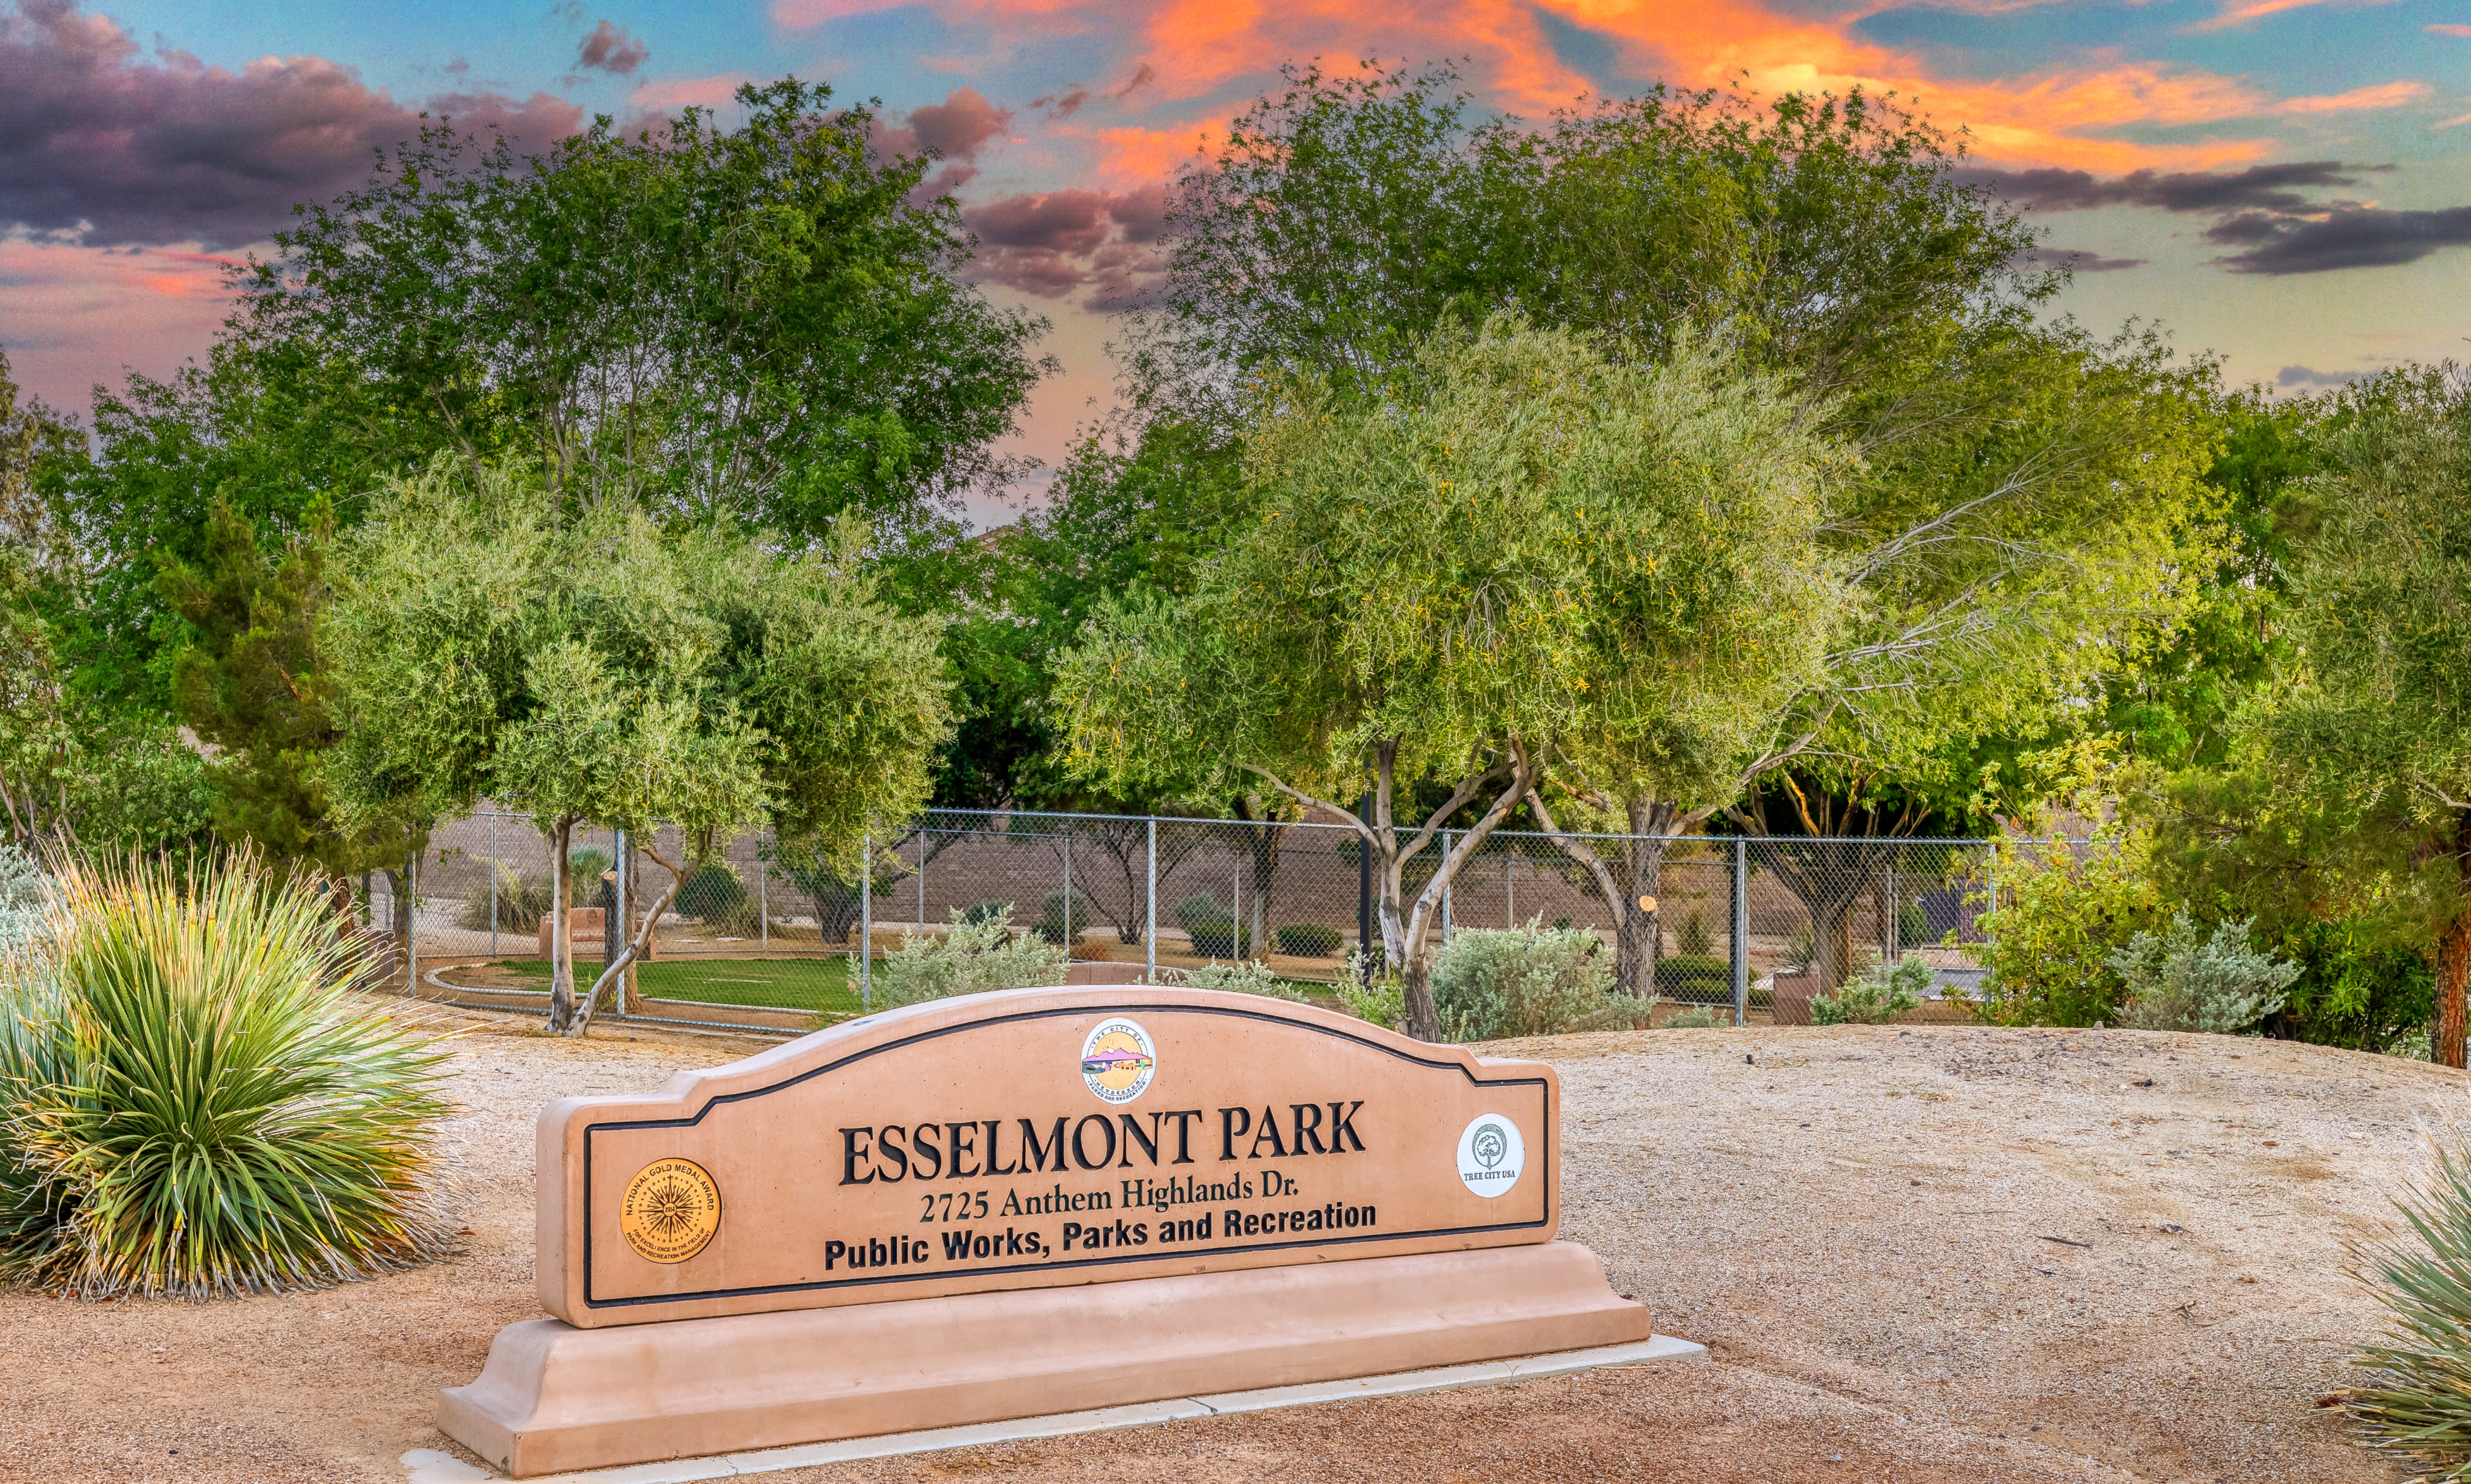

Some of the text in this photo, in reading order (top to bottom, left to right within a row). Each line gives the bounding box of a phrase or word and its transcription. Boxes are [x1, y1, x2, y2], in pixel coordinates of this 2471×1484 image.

[1093, 1031, 1105, 1046] THE
[1133, 1033, 1141, 1042] OF
[1089, 1083, 1104, 1098] PARKS
[1116, 1081, 1147, 1101] RECREATION
[1096, 1079, 1140, 1095] HENDERSON
[838, 1100, 1367, 1186] ESSELMONT PARK
[1464, 1173, 1483, 1181] TREE
[1485, 1171, 1500, 1179] CITY
[626, 1164, 714, 1216] NATIONAL GOLD MEDAL AWARD
[919, 1170, 1300, 1224] 2725 Anthem Highlands Dr.
[625, 1230, 711, 1259] PARK AND RECREATION MANAGEMENT
[633, 1228, 642, 1240] FOR
[687, 1235, 700, 1246] FIELD
[699, 1226, 705, 1236] OF
[825, 1201, 1376, 1271] Public Works, Parks and Recreation
